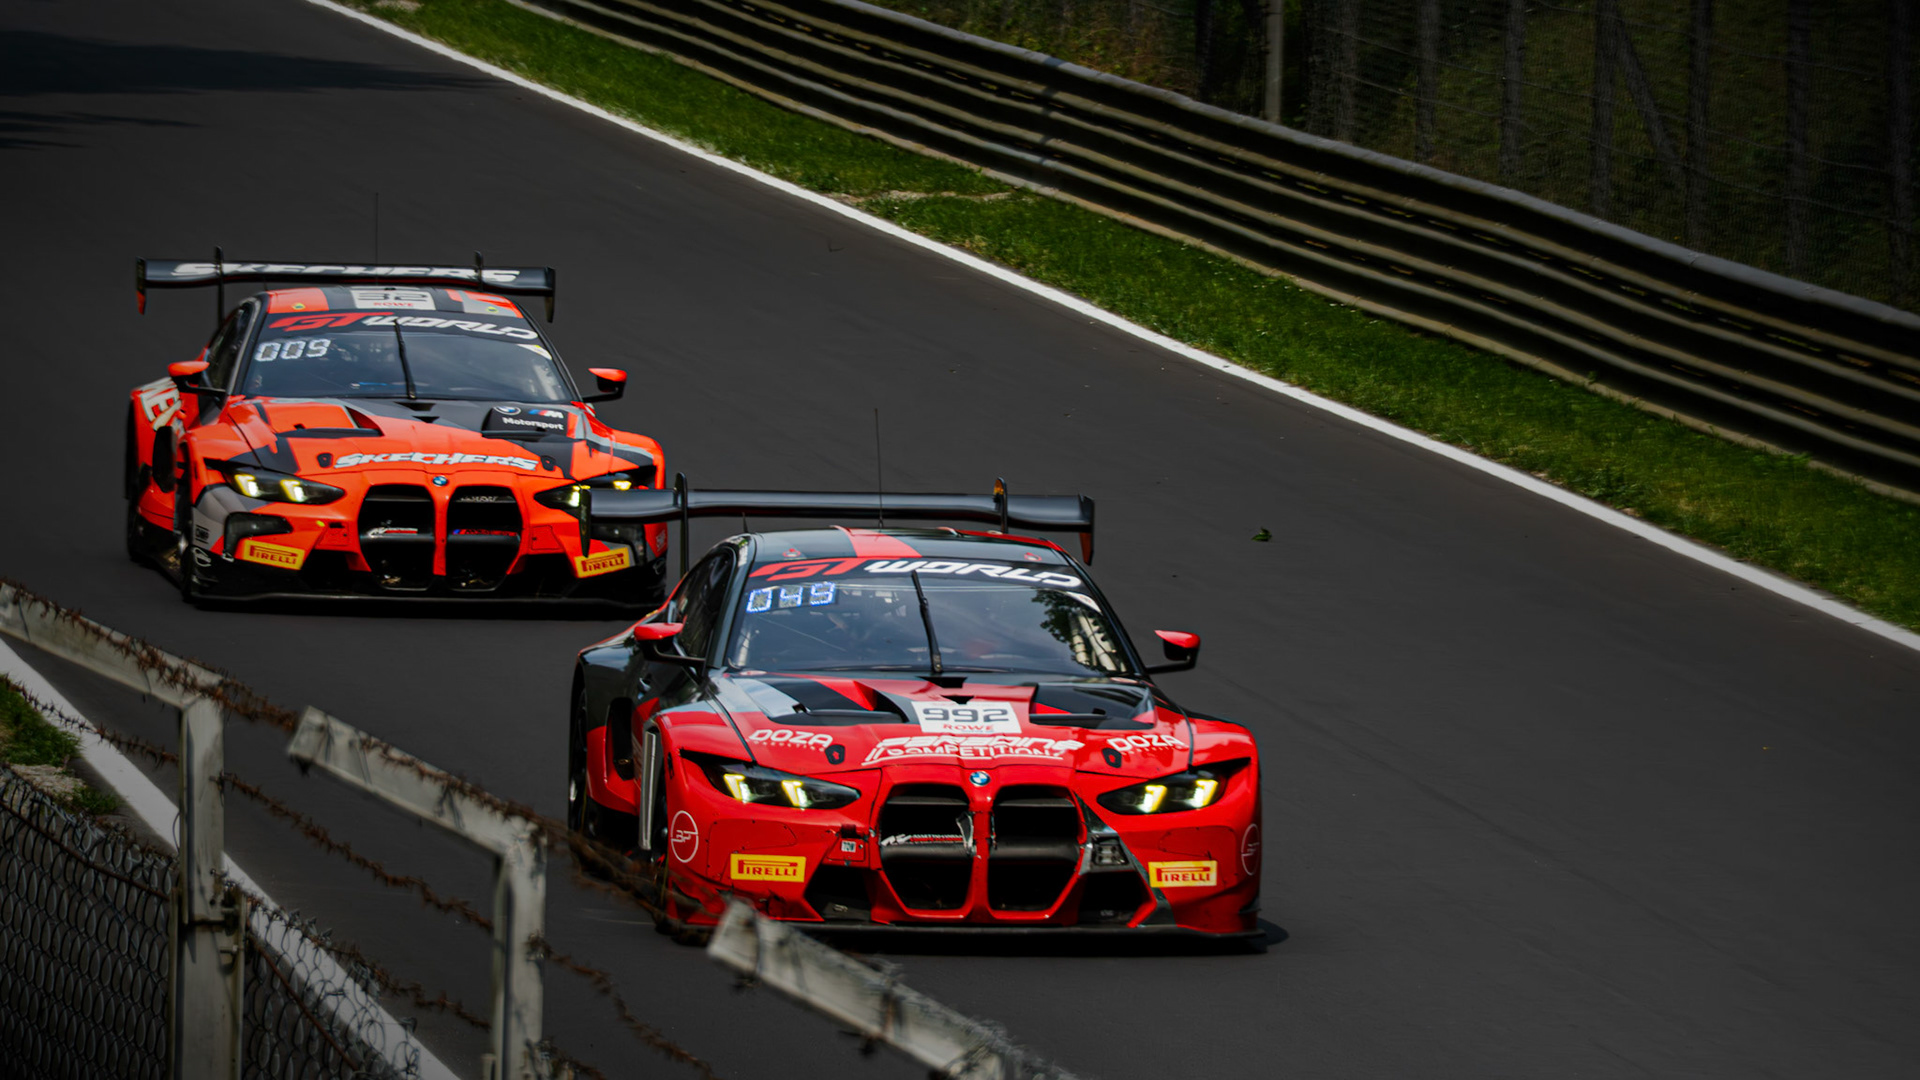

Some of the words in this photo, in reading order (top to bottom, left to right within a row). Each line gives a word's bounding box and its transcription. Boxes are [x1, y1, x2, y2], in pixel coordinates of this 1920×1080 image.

[268, 311, 394, 332] GT
[362, 315, 539, 340] WORLD
[255, 338, 331, 362] 009
[502, 417, 564, 431] Motorsport
[334, 452, 539, 471] SKECHERS
[249, 545, 299, 565] PIRELLI
[581, 552, 625, 572] PIRELLI
[748, 557, 902, 582] GT
[863, 560, 1082, 588] WORLD
[746, 581, 836, 614] 049
[922, 707, 1009, 723] 992
[943, 723, 995, 731] ROWE
[749, 729, 834, 748] DOZA
[1106, 734, 1189, 752] DOZA
[738, 859, 799, 877] PIRELLI
[1156, 866, 1212, 883] PIRELLI
